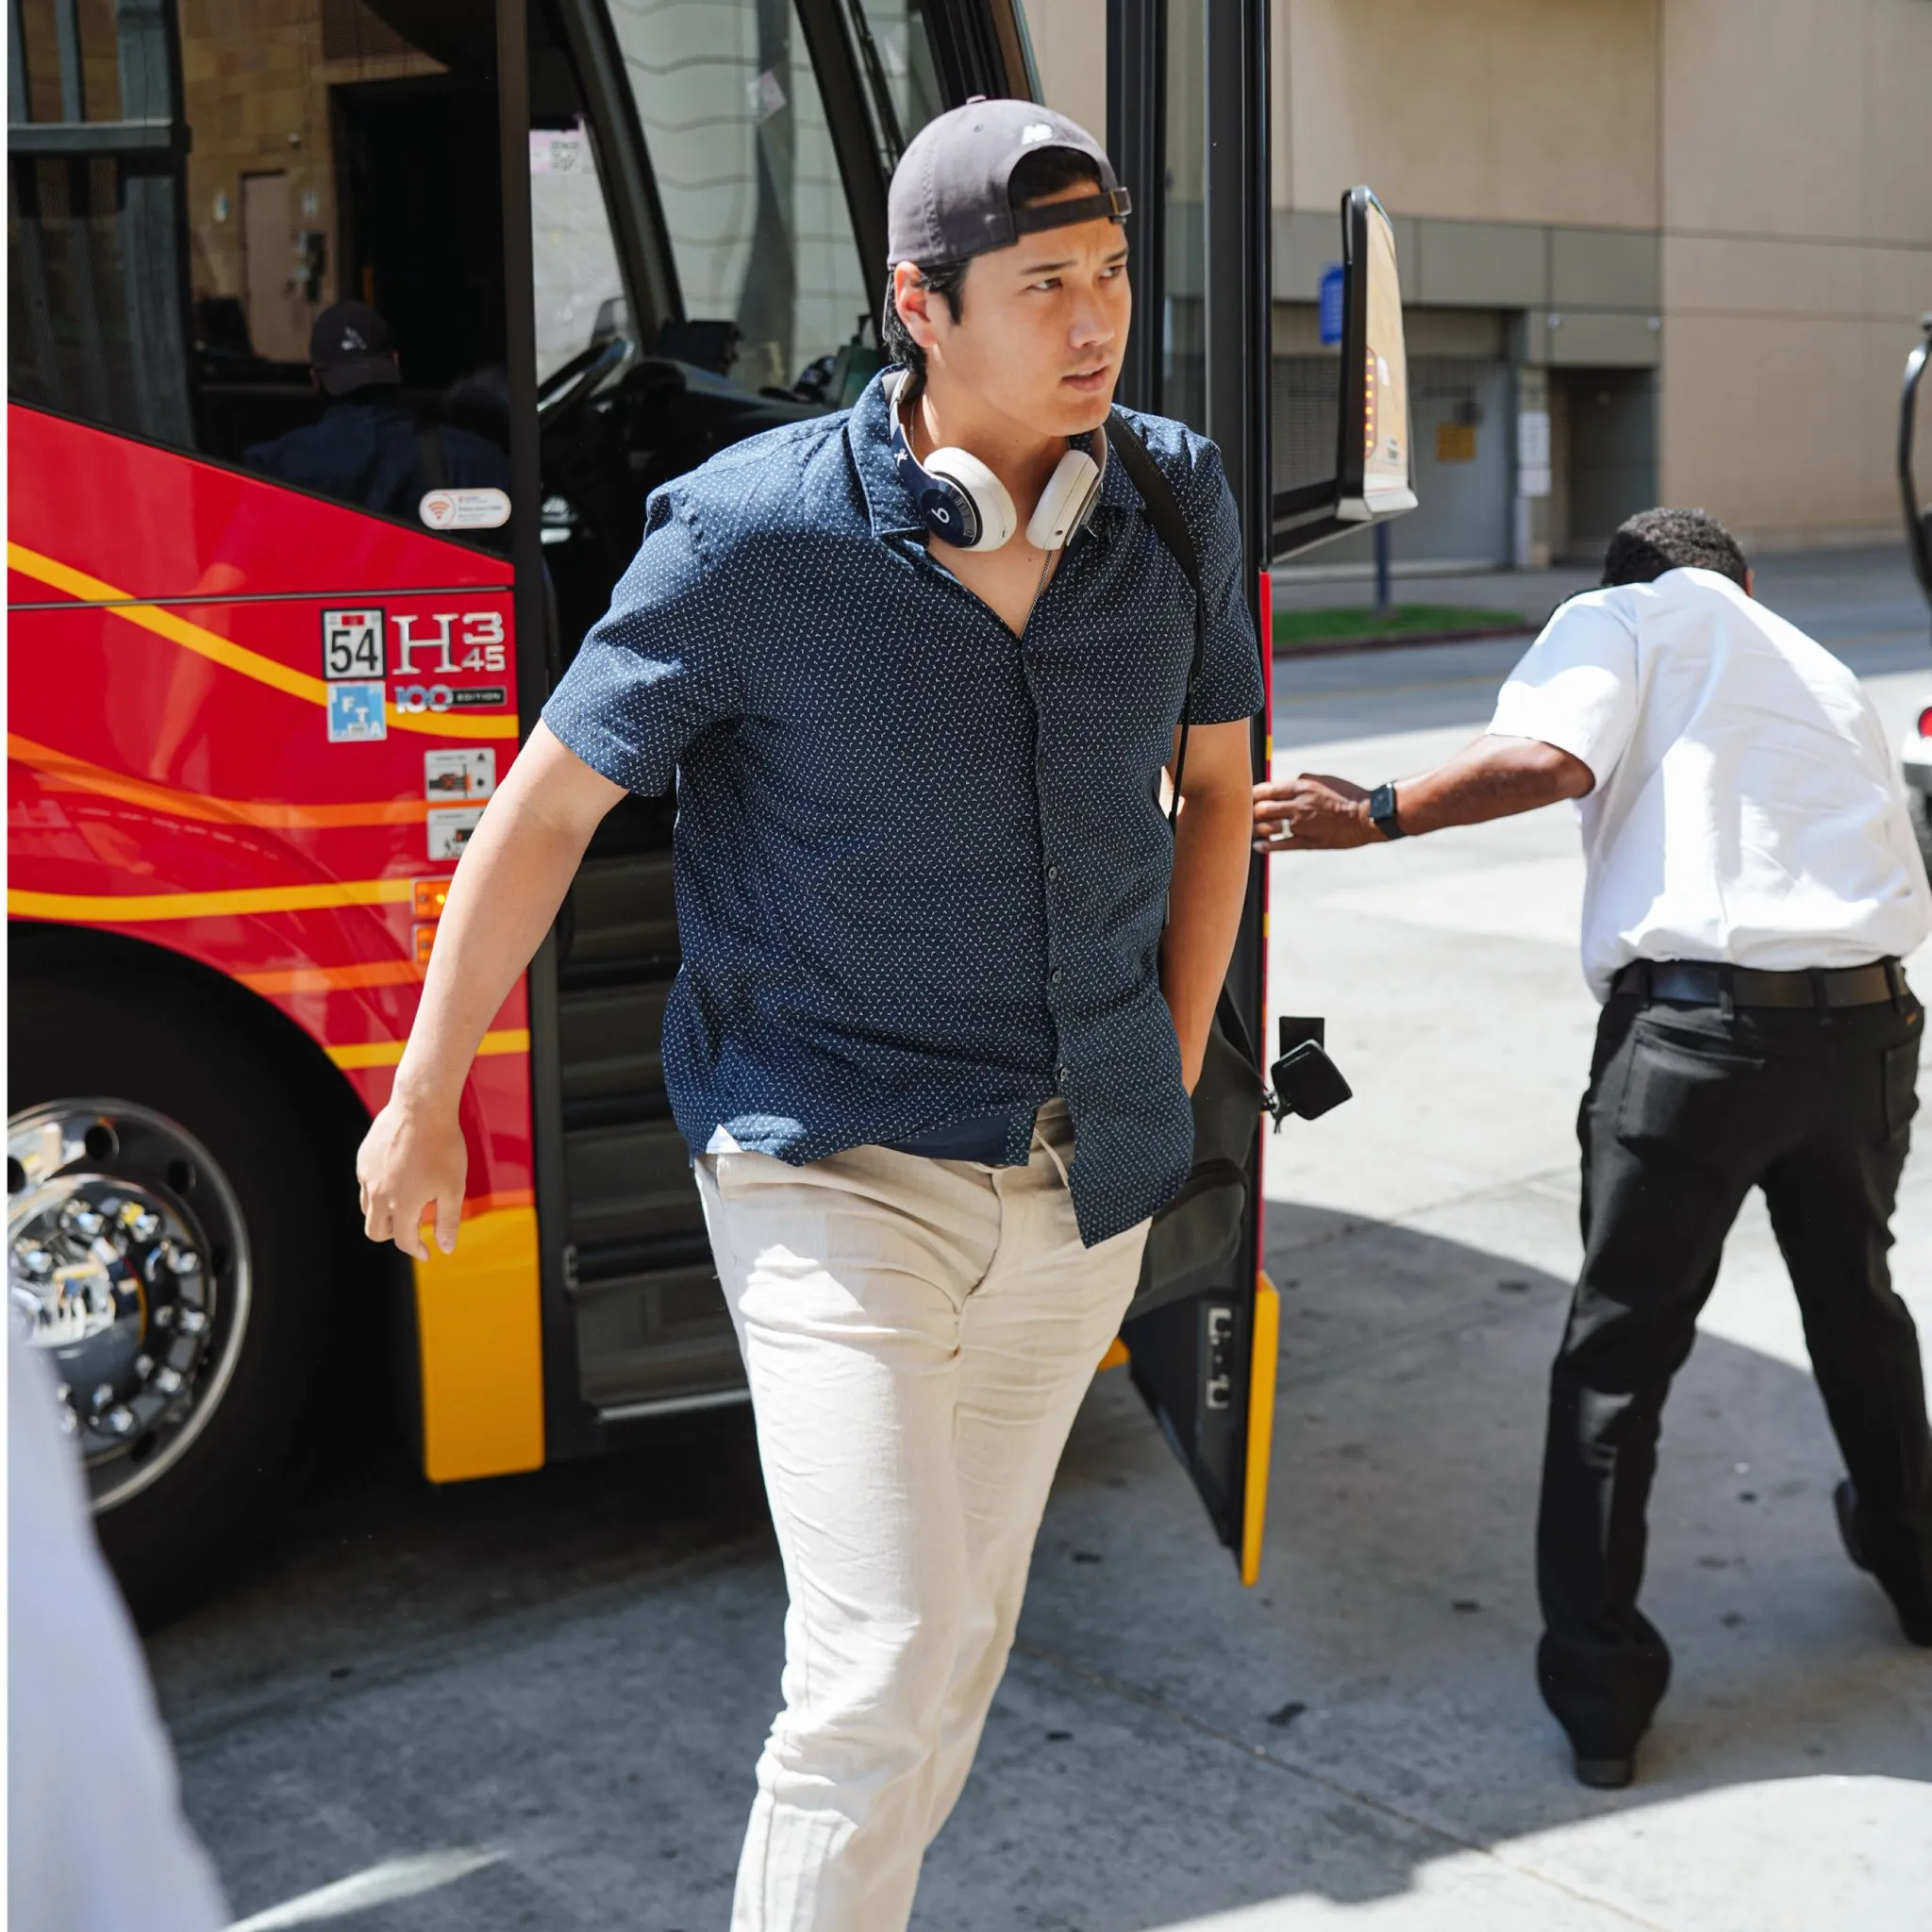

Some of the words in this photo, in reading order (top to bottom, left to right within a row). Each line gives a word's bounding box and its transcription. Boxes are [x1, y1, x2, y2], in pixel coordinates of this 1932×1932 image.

[330, 628, 378, 673] 54
[460, 644, 506, 672] 45
[394, 683, 453, 714] 100
[457, 691, 502, 702] EDITION
